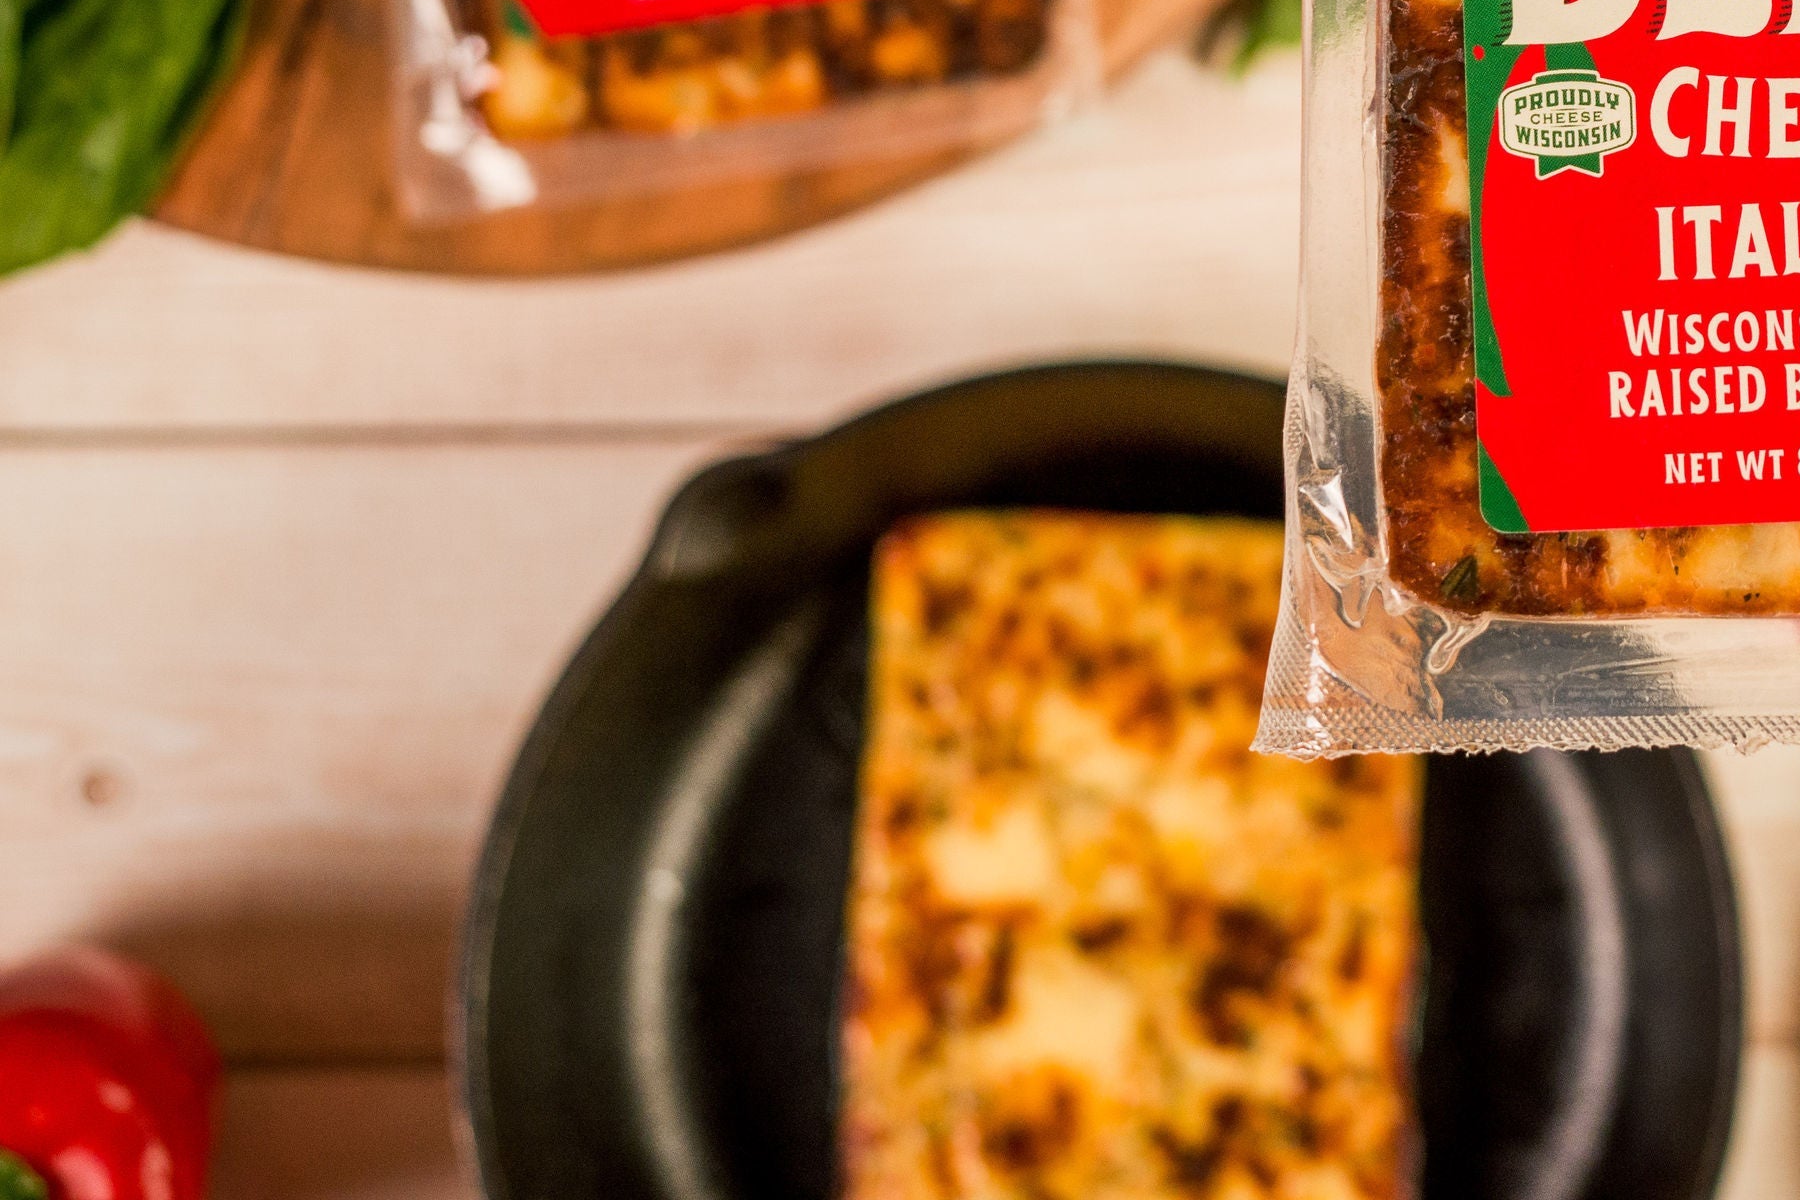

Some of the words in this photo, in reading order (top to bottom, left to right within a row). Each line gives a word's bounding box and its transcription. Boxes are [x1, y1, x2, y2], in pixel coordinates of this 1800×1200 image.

[1514, 88, 1620, 116] PROUDLY
[1530, 110, 1603, 125] CHEESE
[1515, 120, 1621, 149] WISCONSIN
[1608, 365, 1766, 418] RAISED
[1665, 452, 1723, 484] NET
[1736, 449, 1784, 480] WT
